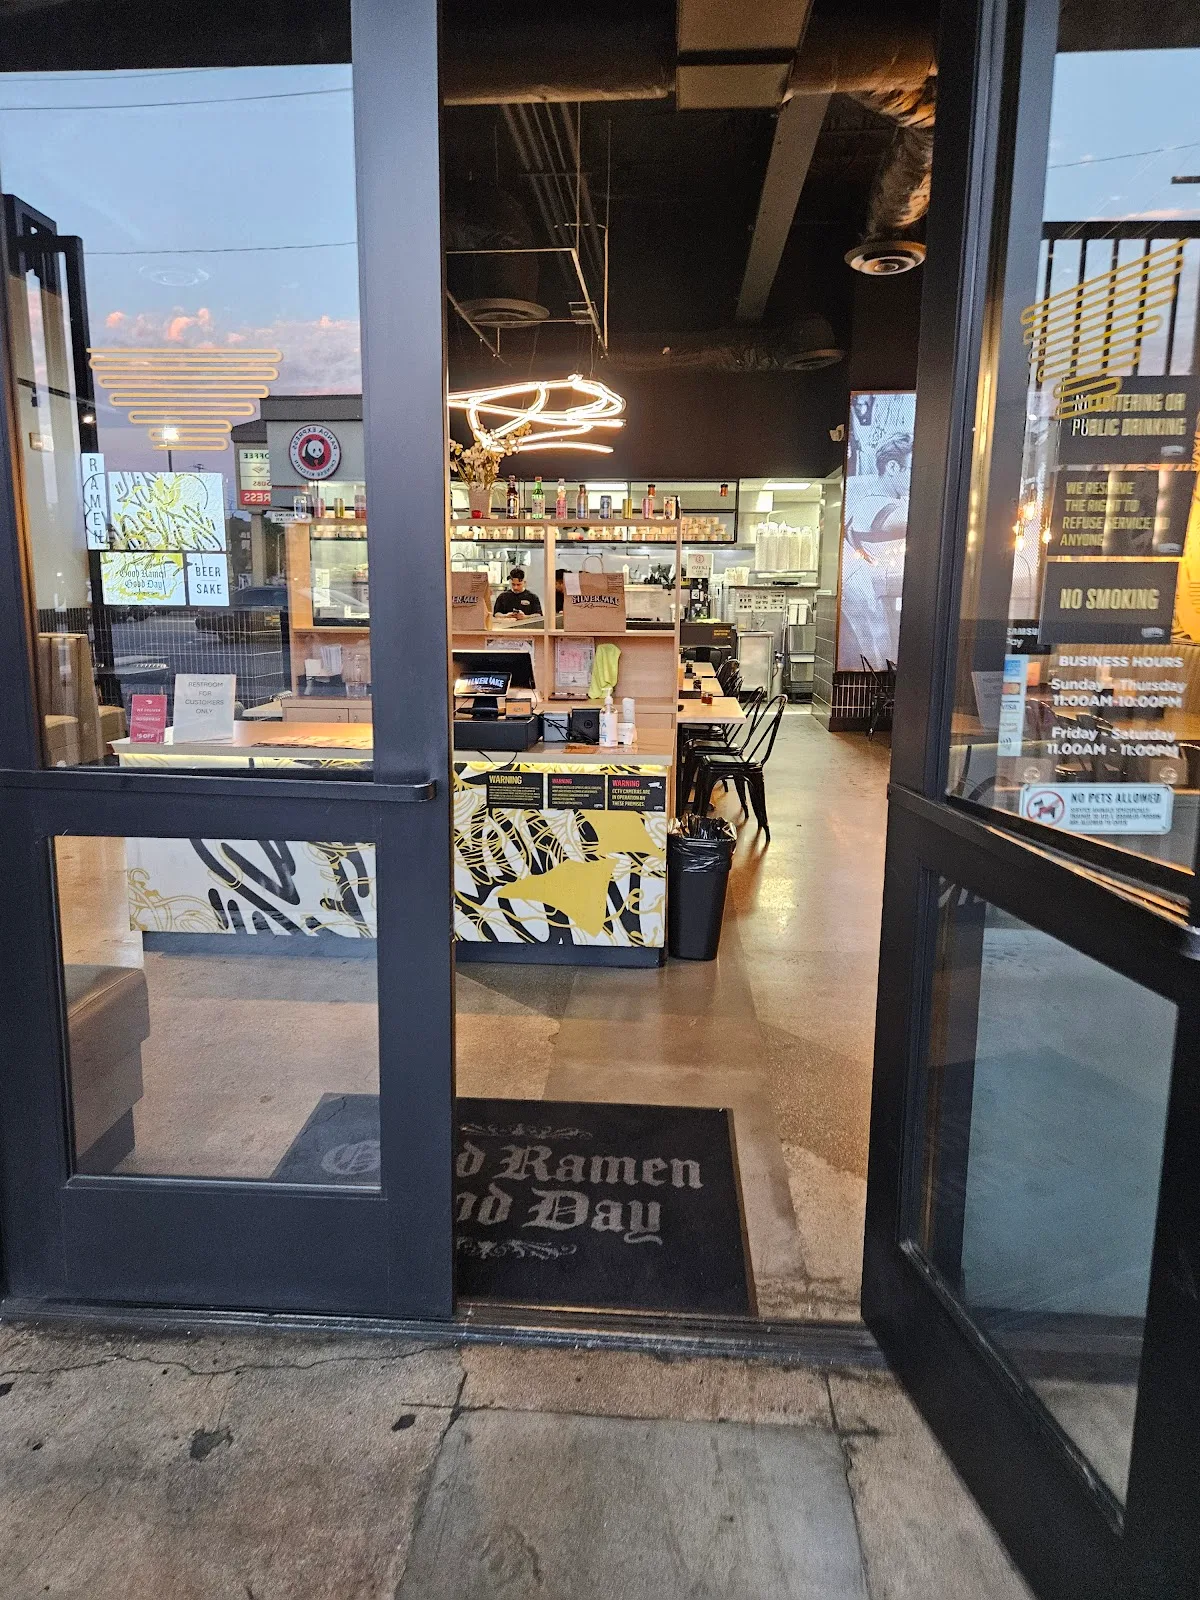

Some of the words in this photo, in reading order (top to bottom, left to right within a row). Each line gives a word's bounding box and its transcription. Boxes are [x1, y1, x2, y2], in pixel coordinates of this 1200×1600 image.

[1072, 418, 1119, 436] PUBLIC
[1121, 418, 1186, 436] DRINKING
[1066, 481, 1084, 495] WE
[89, 458, 103, 544] RAMEN
[1064, 499, 1085, 512] THE
[1062, 517, 1105, 530] REFUSE
[1107, 517, 1151, 530] SERVICE
[1060, 533, 1104, 546] ANYONE
[195, 566, 221, 577] BEER
[196, 584, 222, 594] SAKE
[1060, 588, 1084, 609] NO
[1086, 588, 1159, 610] SMOKING
[1059, 656, 1130, 667] BUSINESS
[1132, 656, 1184, 668] HOURS
[1050, 678, 1105, 692] Sunday
[1120, 679, 1187, 693] Thursday
[1051, 726, 1099, 741] Friday
[1111, 727, 1177, 743] Saturday
[489, 775, 522, 784] WARNING
[1071, 792, 1085, 803] NO
[1088, 792, 1112, 803] PETS
[1115, 792, 1161, 804] ALLOWED
[493, 1143, 703, 1189] Ramen
[521, 1187, 662, 1246] Day
